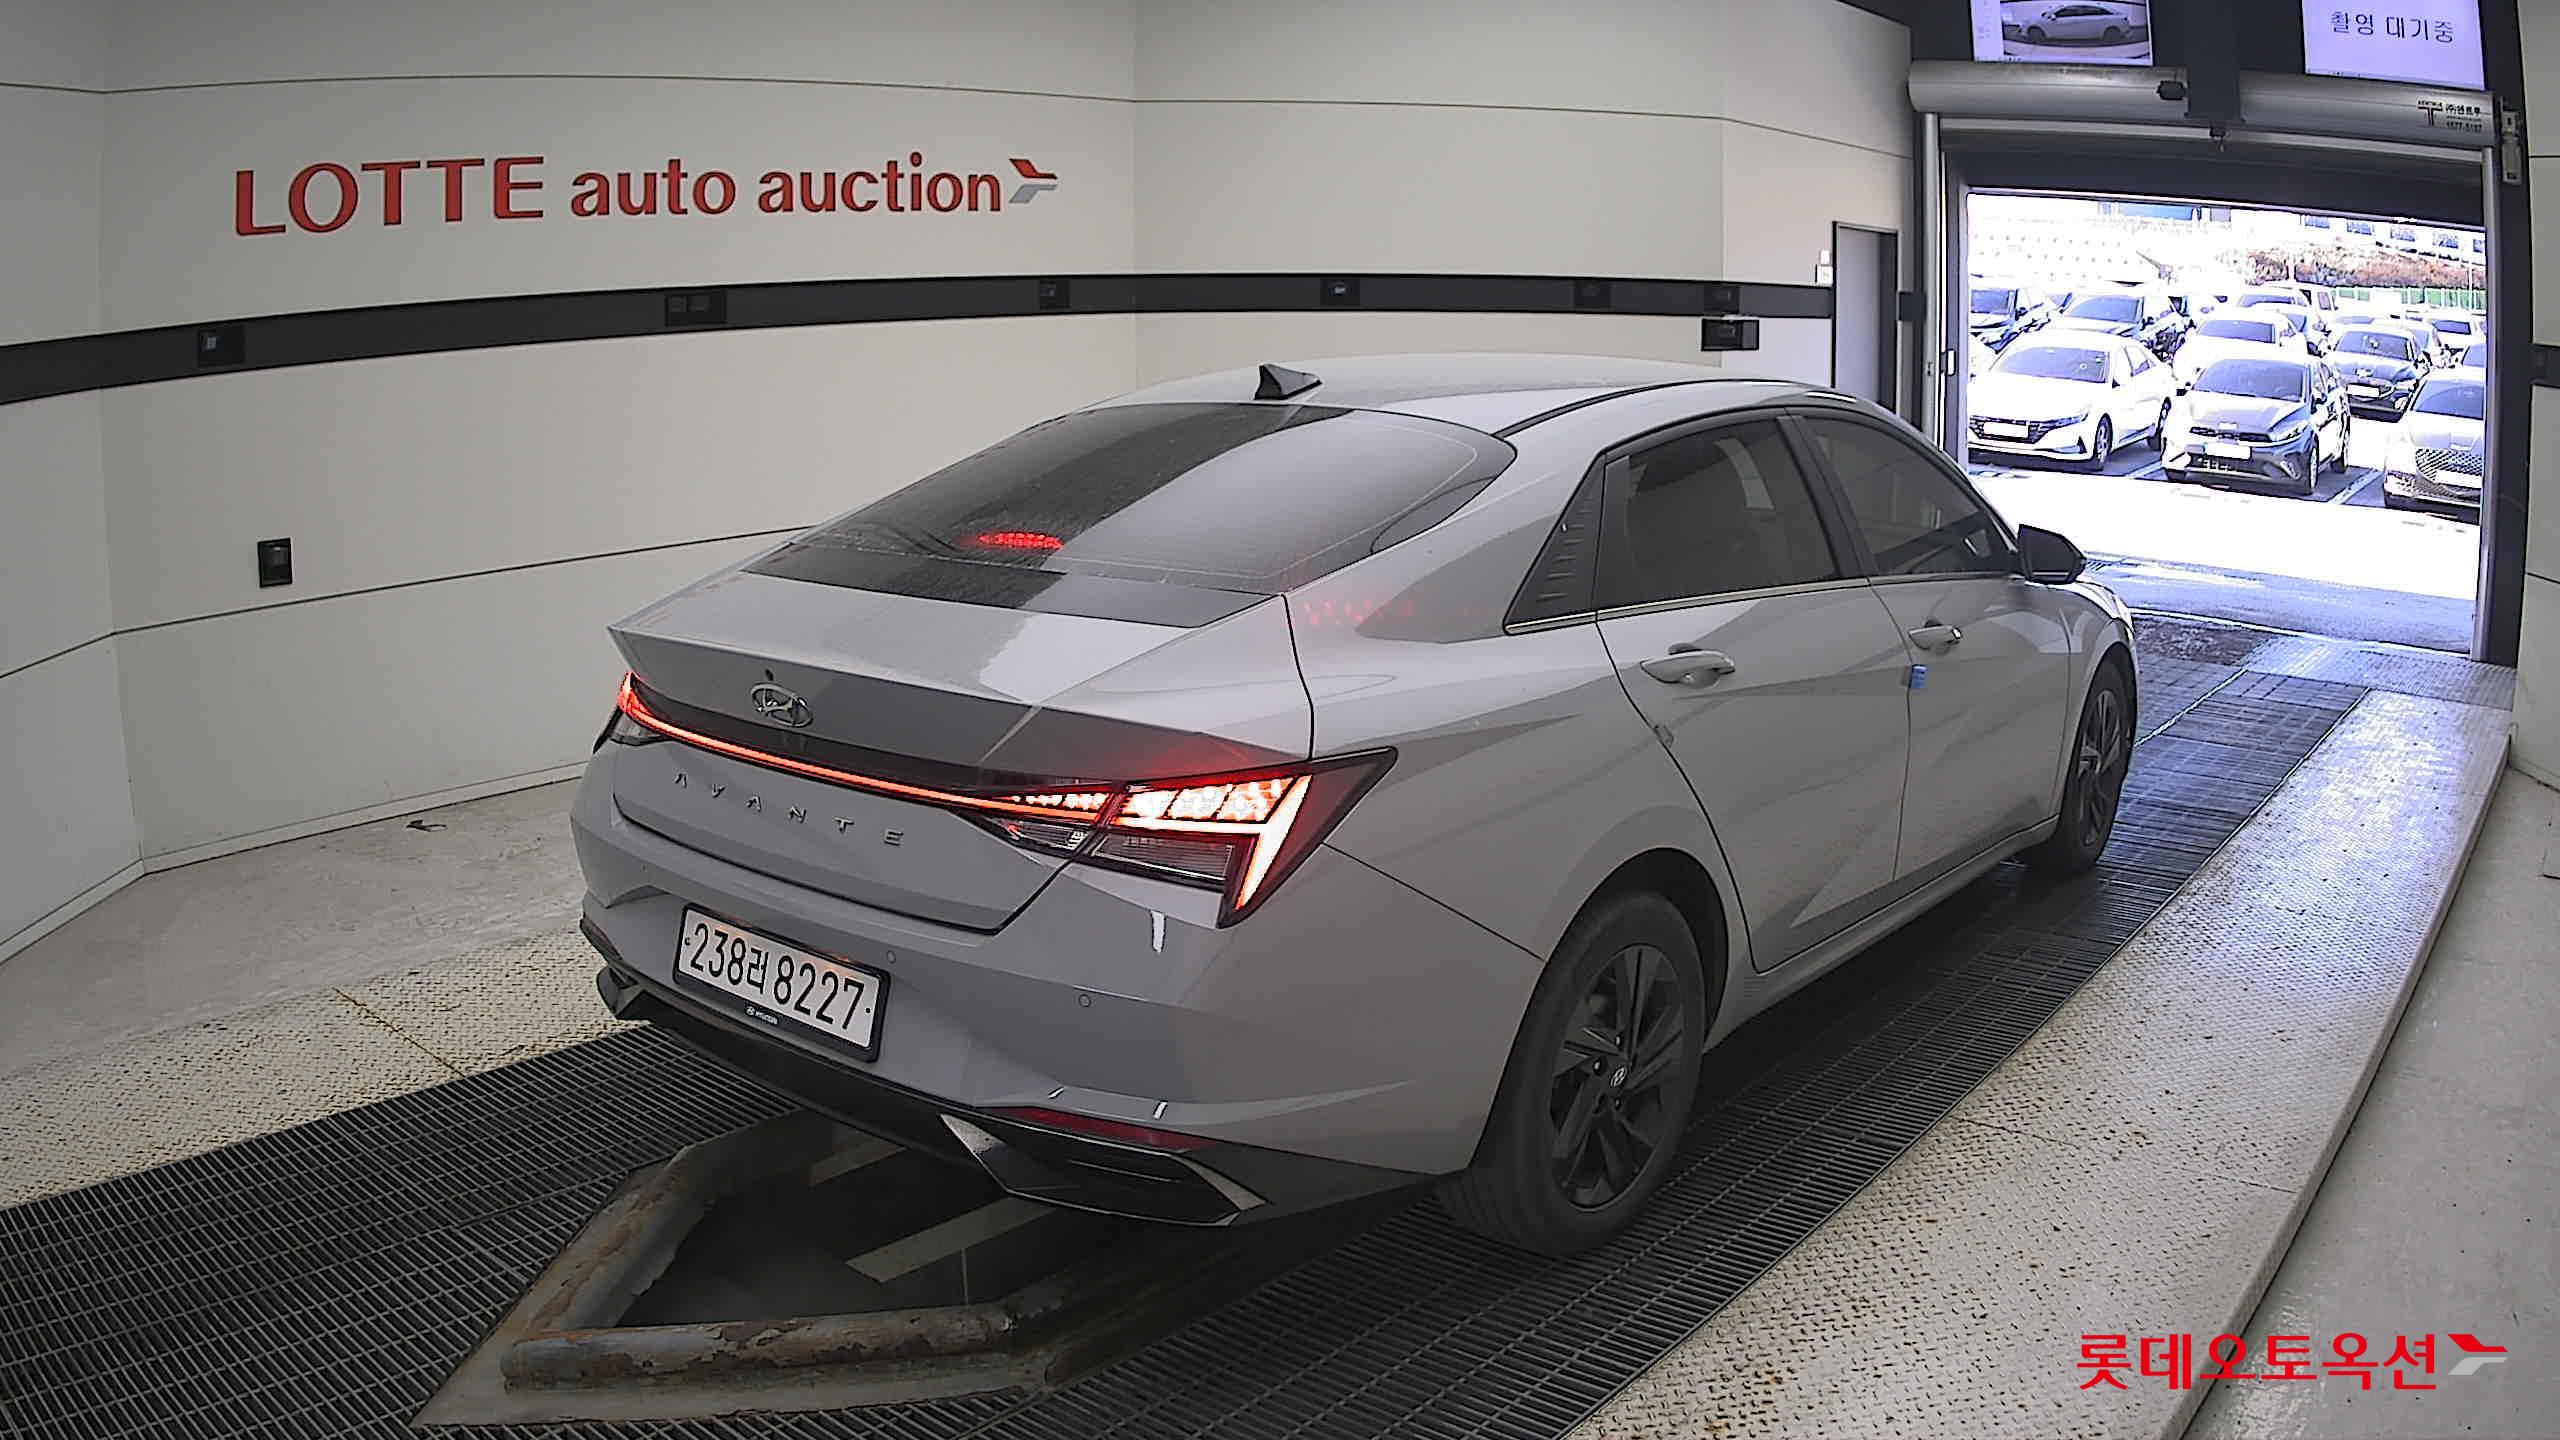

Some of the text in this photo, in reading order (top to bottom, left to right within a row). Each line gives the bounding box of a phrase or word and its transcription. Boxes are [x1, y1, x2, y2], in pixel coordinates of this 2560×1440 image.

[2332, 11, 2454, 44] 촬영 대기중
[236, 153, 1003, 236] LOTTE auto auction
[673, 771, 905, 846] AVANTE
